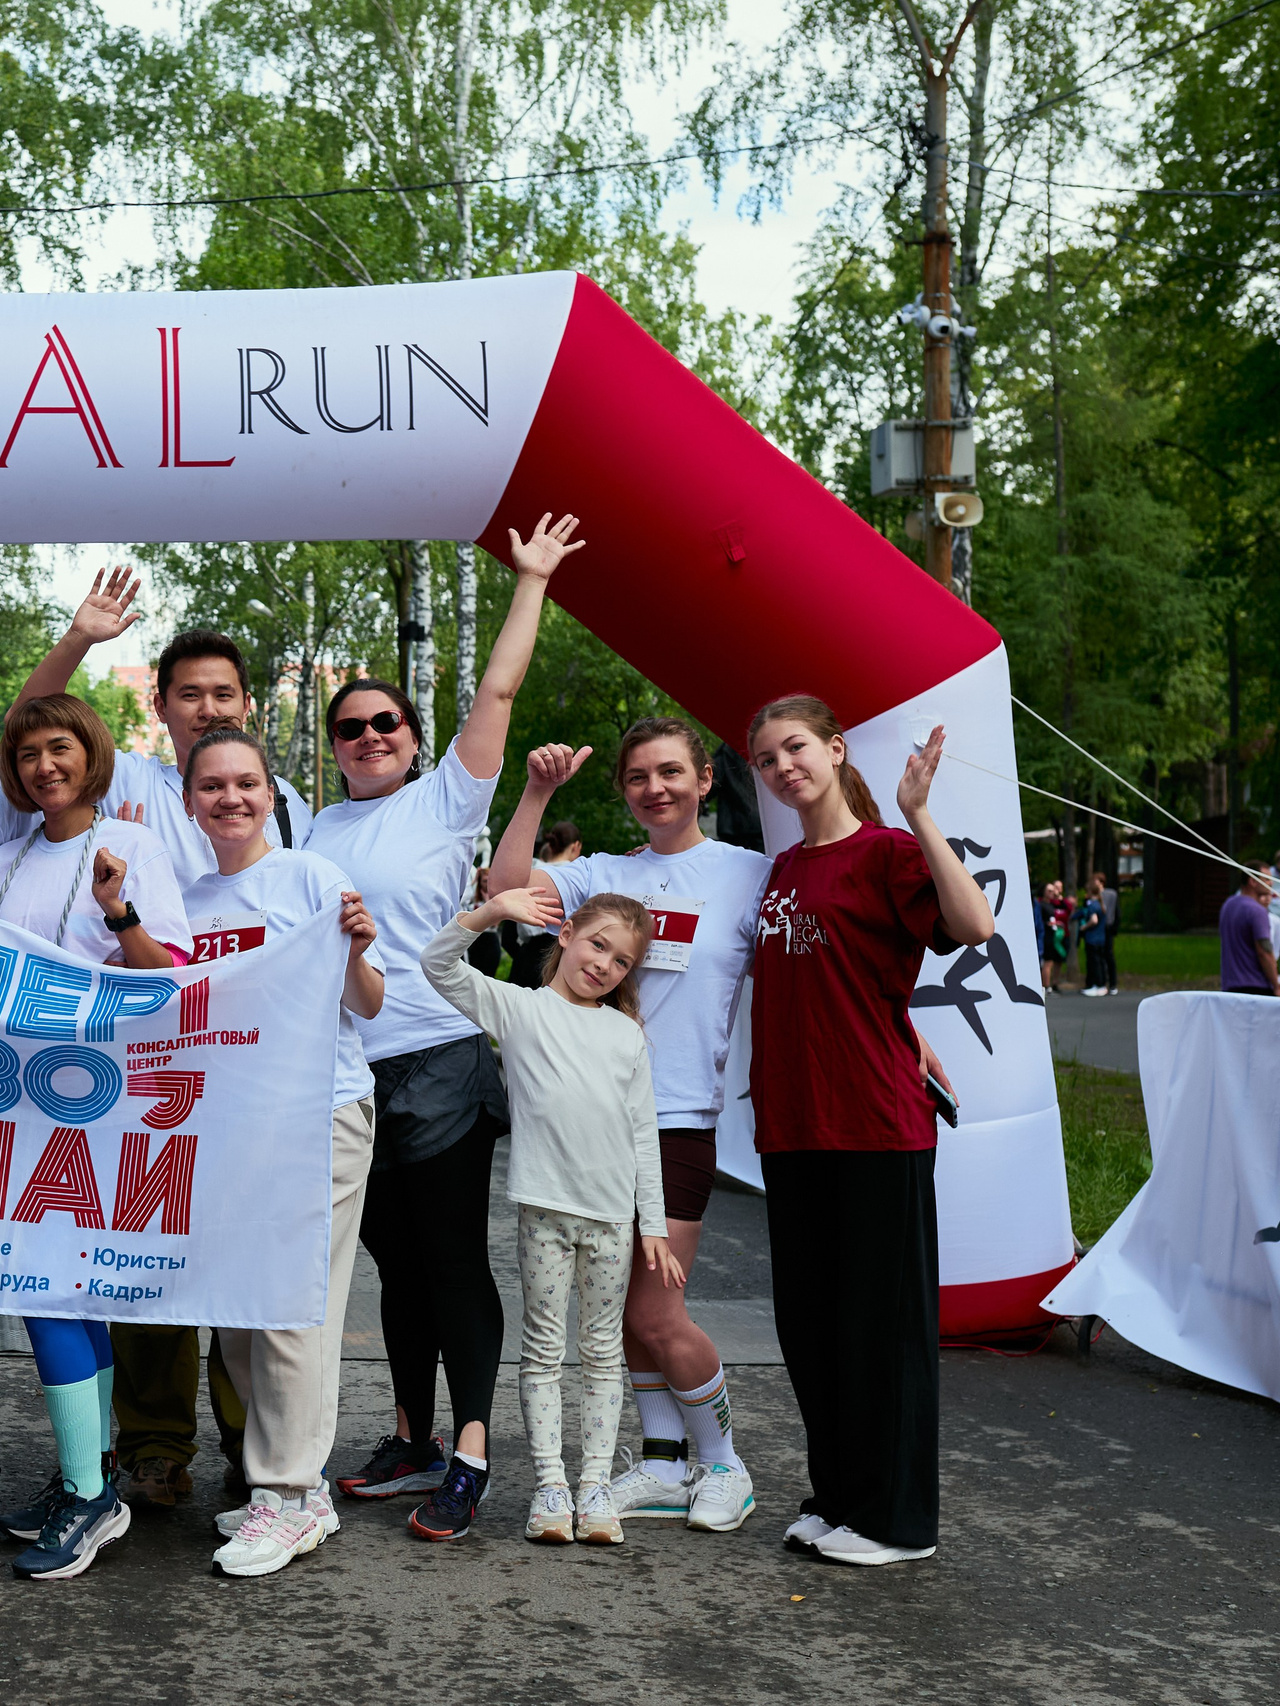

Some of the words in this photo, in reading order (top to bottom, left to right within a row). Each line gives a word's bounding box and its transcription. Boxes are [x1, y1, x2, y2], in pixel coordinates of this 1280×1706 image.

[237, 340, 489, 434] RUN
[793, 914, 818, 927] URAL
[197, 934, 240, 962] 213
[793, 926, 830, 946] LEGAL
[793, 943, 812, 955] RUN
[126, 1027, 260, 1055] КОНСАЛТИНГОВЫЙ
[126, 1055, 173, 1072] ЦЕНТР
[93, 1247, 187, 1272] Юристы
[87, 1278, 163, 1303] Кадры
